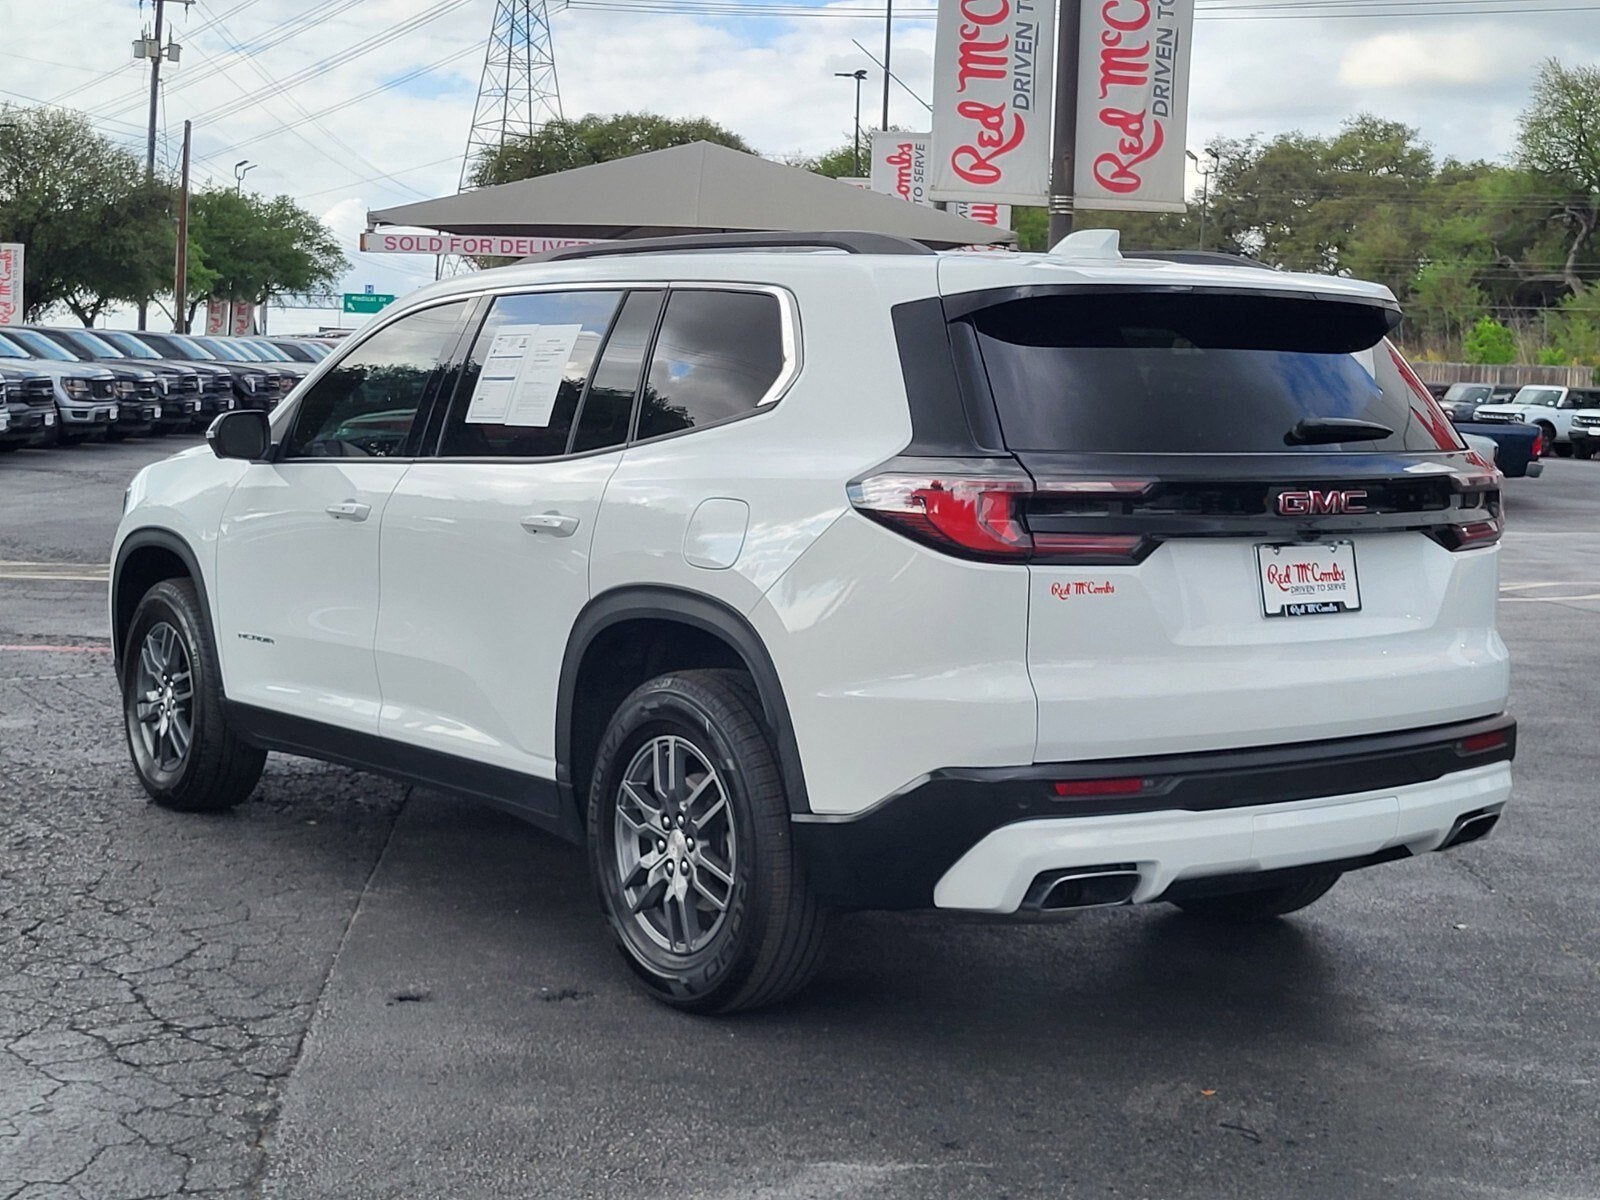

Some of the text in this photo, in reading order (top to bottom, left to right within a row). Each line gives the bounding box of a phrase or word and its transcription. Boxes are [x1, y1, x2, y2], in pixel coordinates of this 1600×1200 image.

[957, 0, 1010, 93] McC
[1012, 0, 1034, 110] DRIVEN T
[1093, 0, 1164, 193] Red McC
[1152, 27, 1174, 117] DRIVEN
[914, 143, 926, 184] SERVE
[952, 101, 1025, 184] Red
[886, 142, 913, 201] ombs
[384, 235, 443, 252] SOLD
[450, 238, 492, 253] FOR
[1278, 490, 1367, 515] GMC
[1051, 581, 1115, 600] Red McCombs
[1267, 562, 1345, 592] Red McCombs
[1290, 583, 1346, 594] DRIVEN TO SERVE
